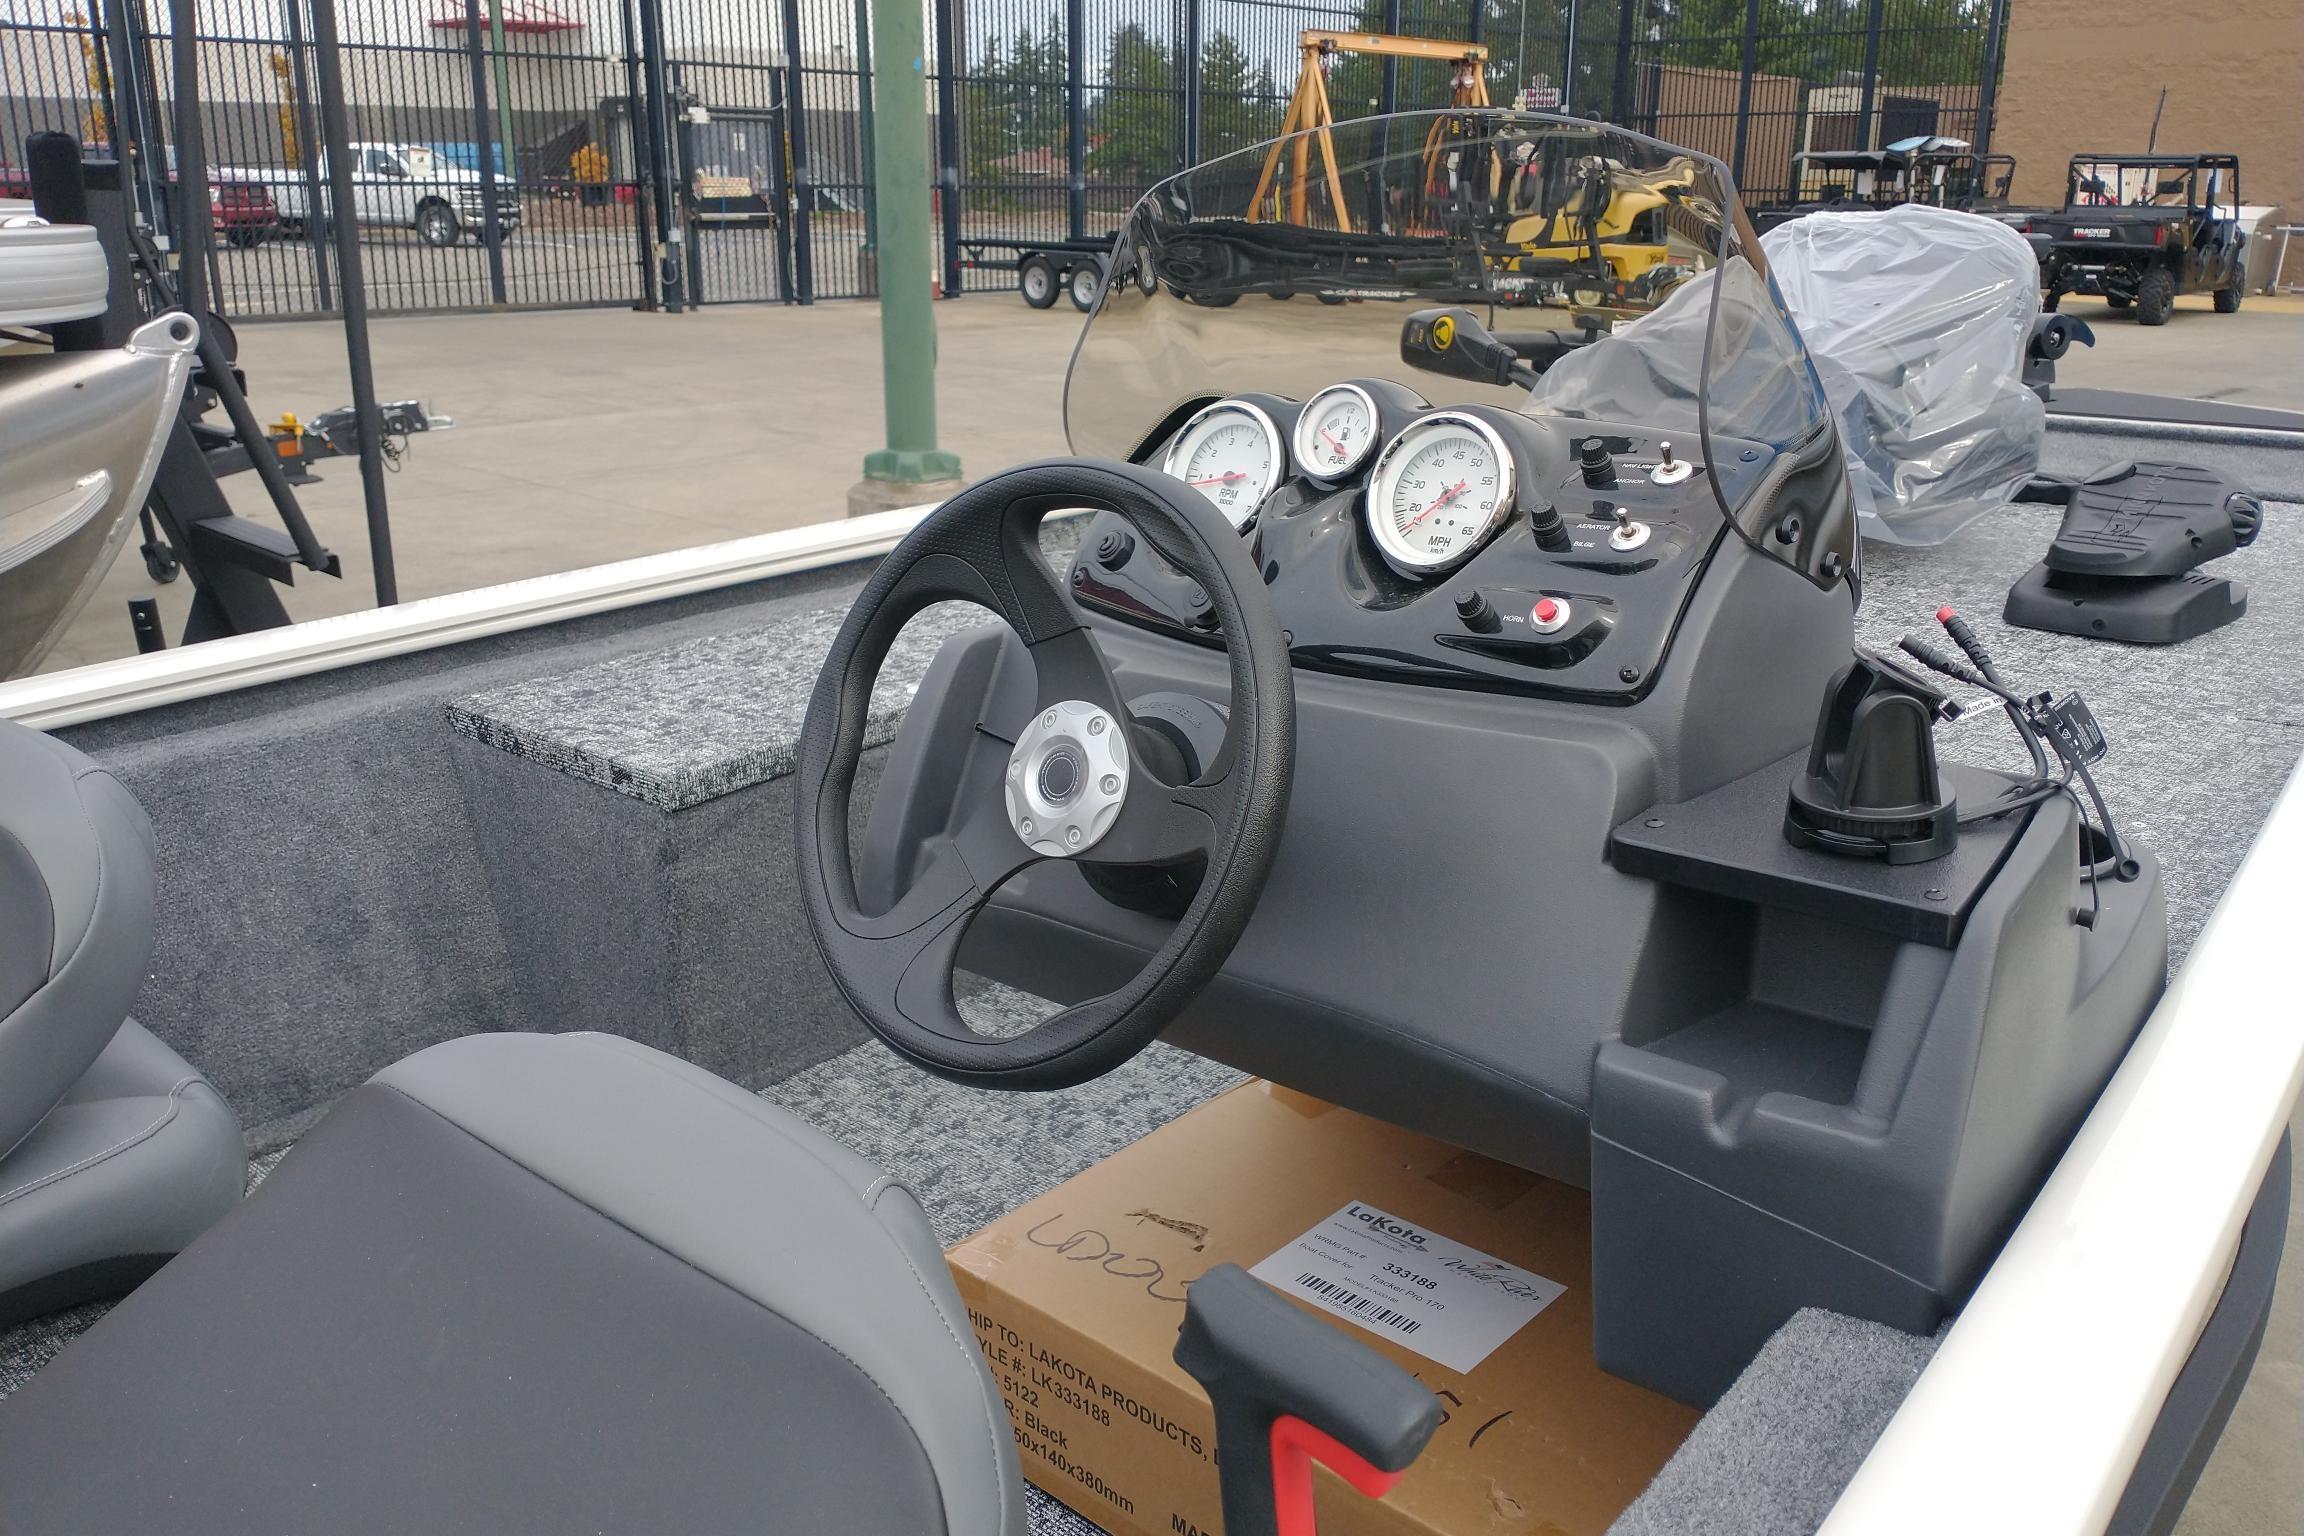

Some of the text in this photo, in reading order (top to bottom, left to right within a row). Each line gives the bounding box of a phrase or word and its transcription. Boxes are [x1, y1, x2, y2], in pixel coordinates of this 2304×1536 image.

[2073, 228, 2111, 236] TRACKER
[1228, 438, 1235, 446] 3
[1247, 440, 1254, 448] 4
[1211, 449, 1218, 458] 2
[1452, 451, 1466, 460] 45
[1261, 460, 1269, 469] 5
[1327, 455, 1347, 465] FUEL
[1432, 458, 1445, 468] 40
[1469, 458, 1483, 468] 50
[1412, 480, 1426, 489] 30
[1480, 476, 1494, 486] 55
[1218, 488, 1239, 500] RPM
[1245, 505, 1252, 513] 7
[1409, 503, 1422, 512] 20
[1480, 501, 1493, 510] 60
[1461, 526, 1474, 536] 65
[1576, 523, 1611, 531] AERATOR
[1428, 535, 1452, 547] MPH
[1502, 614, 1525, 623] HORN
[1963, 700, 1991, 716] Made
[1346, 1205, 1428, 1245] LaKota
[1298, 1242, 1318, 1254] Boat
[1318, 1250, 1342, 1266] Cover
[1341, 1246, 1360, 1258] Part
[1382, 1262, 1438, 1291] 333188
[1369, 1273, 1446, 1312] Tracker Pro 170
[968, 1307, 993, 1331] HIP
[997, 1323, 1024, 1353] TO:
[1029, 1341, 1097, 1395] LAKOTA
[1101, 1383, 1208, 1463] PRODUCTS,
[977, 1335, 1008, 1368] YLE
[1031, 1367, 1111, 1428] LK333188
[1003, 1374, 1039, 1409] 5122
[1024, 1410, 1069, 1451] Black
[1012, 1424, 1135, 1515] 50x140x380mm
[1172, 1511, 1211, 1536] MA
